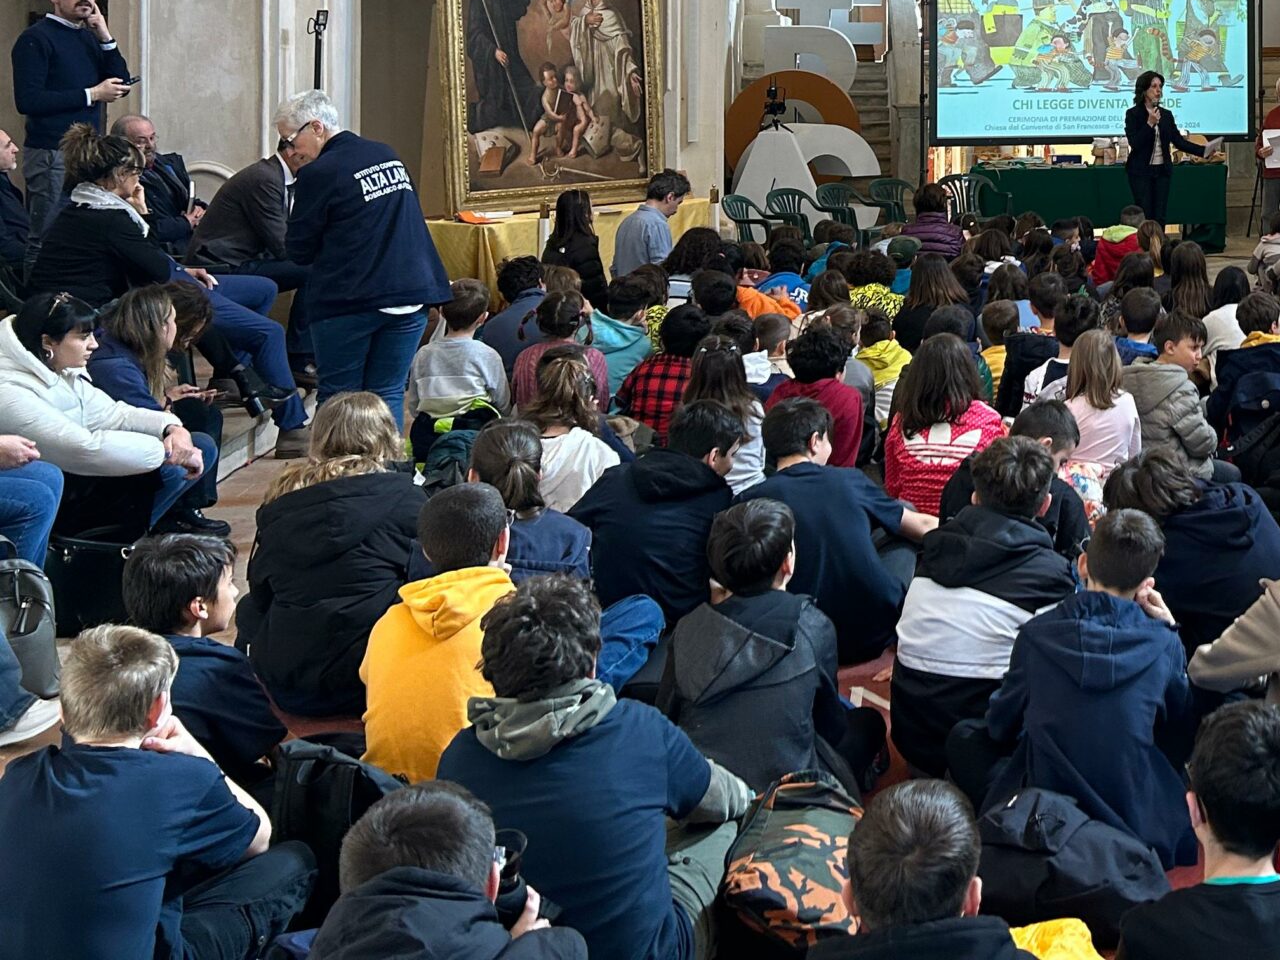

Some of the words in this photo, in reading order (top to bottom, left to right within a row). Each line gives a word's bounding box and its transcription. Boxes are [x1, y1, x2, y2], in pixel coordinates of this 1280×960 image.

[1013, 99, 1032, 110] CHI
[1036, 99, 1074, 110] LEGGE
[1078, 98, 1129, 109] DIVENTA
[353, 165, 380, 179] ISTITUTO
[360, 171, 389, 194] ALTA
[387, 166, 410, 183] LAN
